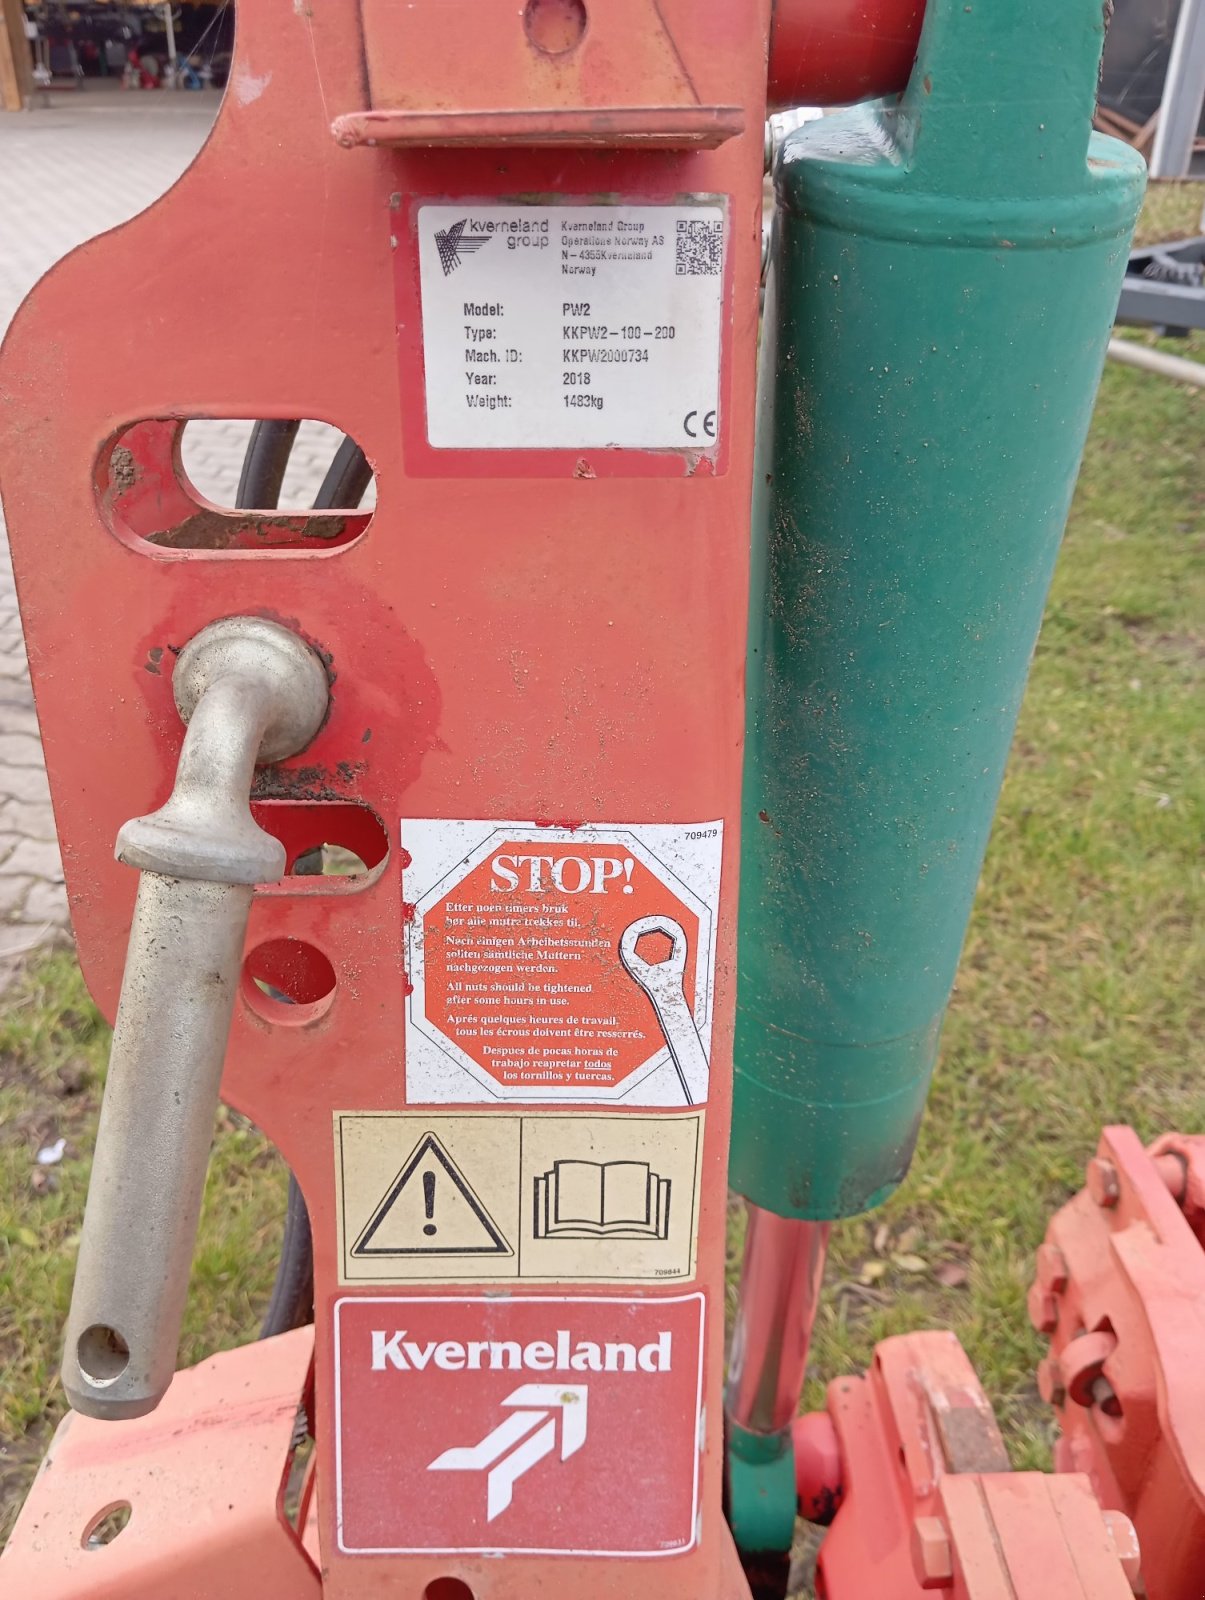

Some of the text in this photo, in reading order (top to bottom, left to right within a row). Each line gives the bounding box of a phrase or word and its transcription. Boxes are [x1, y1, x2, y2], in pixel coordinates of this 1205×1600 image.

[470, 219, 549, 232] kverneland
[562, 221, 644, 232] Kverneland Group
[507, 234, 549, 249] group
[562, 236, 664, 246] Operations Norway AS
[562, 265, 596, 275] Norway
[464, 303, 590, 316] Model: PW2
[464, 327, 496, 341] Type:
[465, 349, 649, 363] Mach. ID: KKPW2000734
[466, 372, 590, 385] Year: 2018
[466, 395, 603, 410] Weight: 1483kg
[685, 829, 717, 840] 709479
[490, 855, 634, 894] STOP!
[446, 902, 473, 912] Etter
[542, 904, 568, 913] bruk
[467, 917, 486, 925] alle
[490, 918, 521, 926] mutre
[567, 918, 580, 927] til.
[446, 936, 473, 945] Nach
[477, 936, 514, 947] einigen
[446, 950, 581, 960] sollten sämtliche Muttern
[447, 964, 512, 974] nachgezogen
[447, 983, 461, 991] All
[491, 983, 525, 992] should
[528, 984, 540, 992] be
[543, 984, 592, 994] tightened
[447, 996, 471, 1005] after
[504, 996, 533, 1005] hours
[537, 997, 547, 1005] in
[447, 1014, 477, 1024] Aprés
[481, 1015, 526, 1025] quelques
[530, 1015, 563, 1024] heures
[566, 1016, 579, 1024] de
[456, 1027, 646, 1039] tous les écrous doivent être resserrés.
[483, 1046, 618, 1057] Despues de pocas horas de
[492, 1059, 612, 1070] trabajo reapretar todos
[504, 1071, 614, 1081] los tornillos y tuercas.
[371, 1330, 672, 1372] Kverneland
